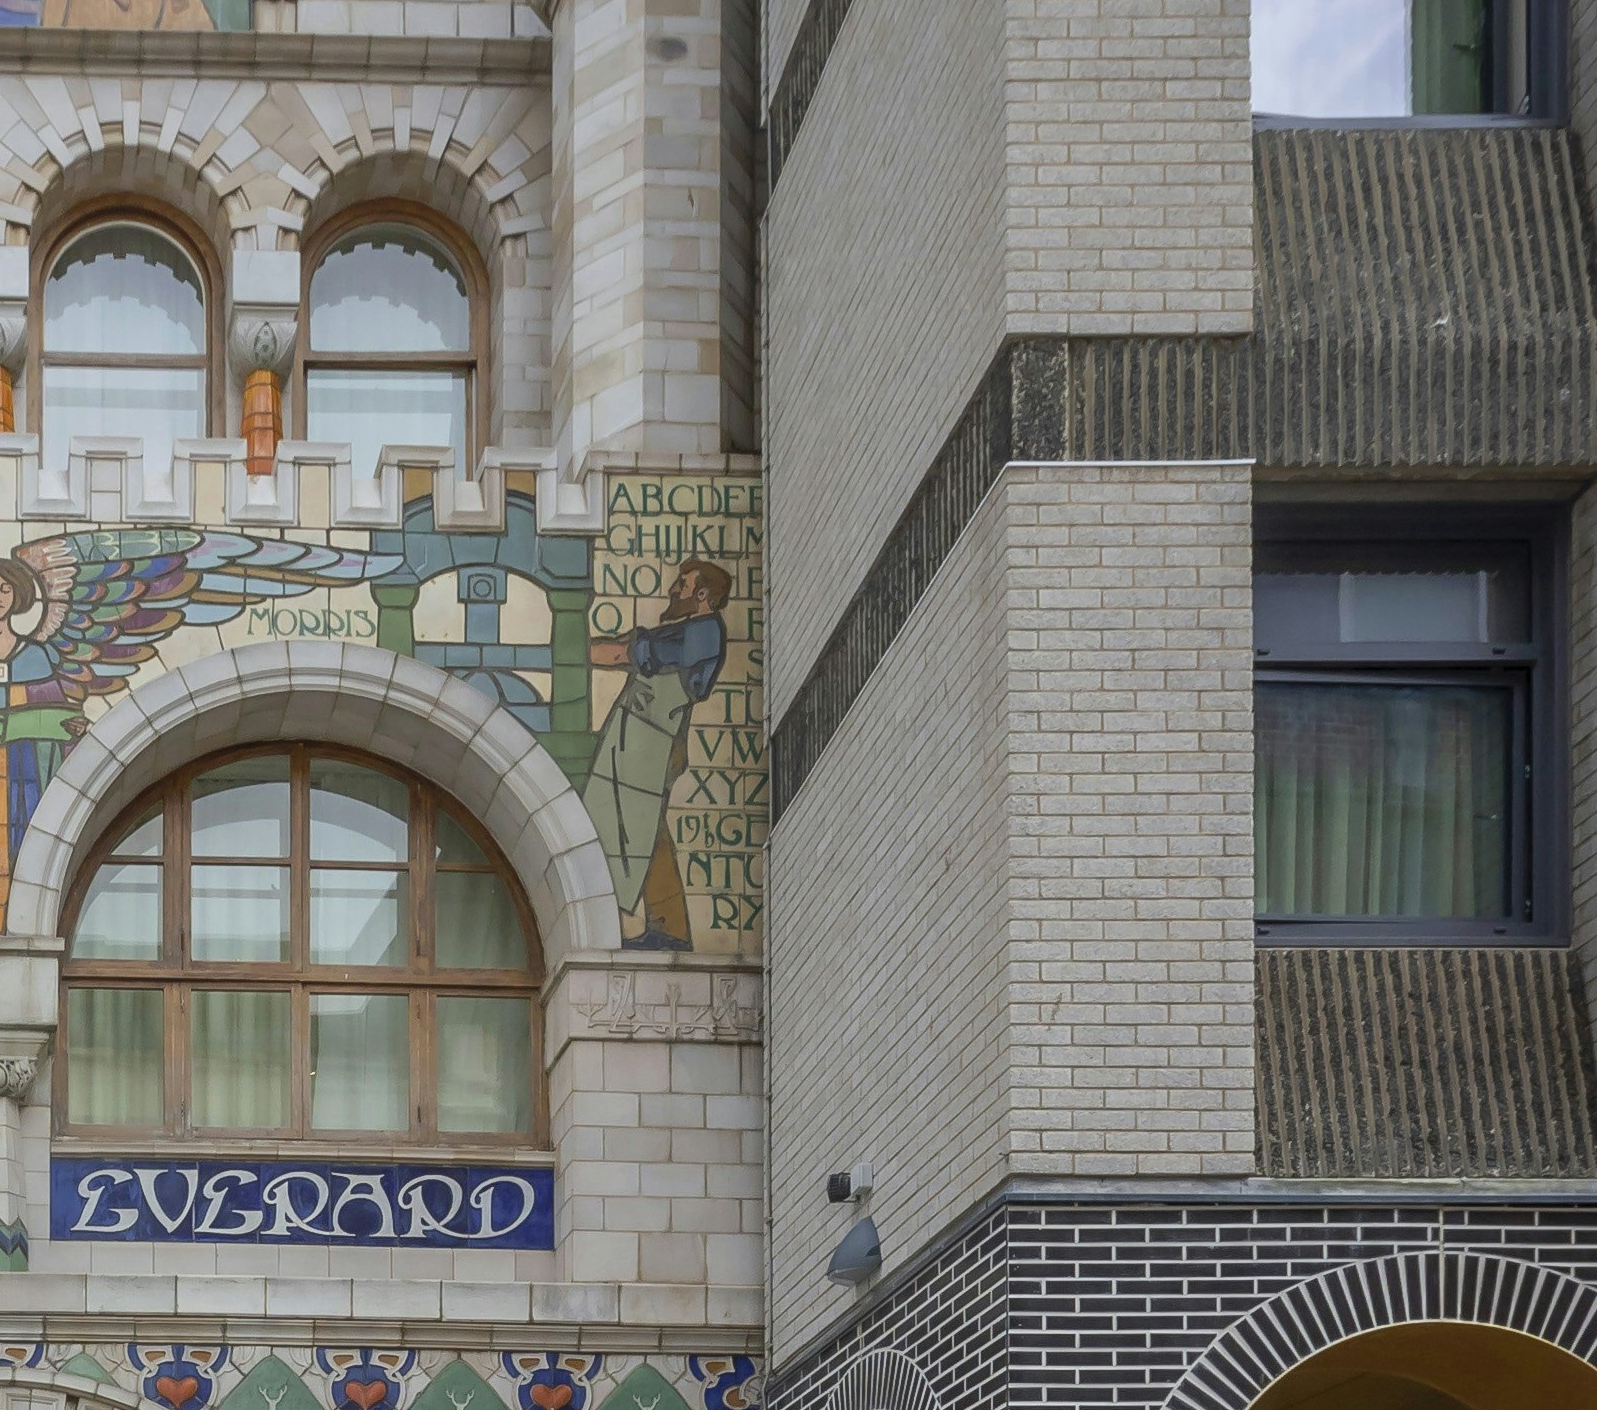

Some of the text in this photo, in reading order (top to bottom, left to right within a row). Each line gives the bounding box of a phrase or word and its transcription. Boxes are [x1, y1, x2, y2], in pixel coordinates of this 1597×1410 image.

[247, 607, 376, 637] MORRIS
[685, 769, 769, 806] XYZ
[70, 1168, 535, 1239] EVERARD
